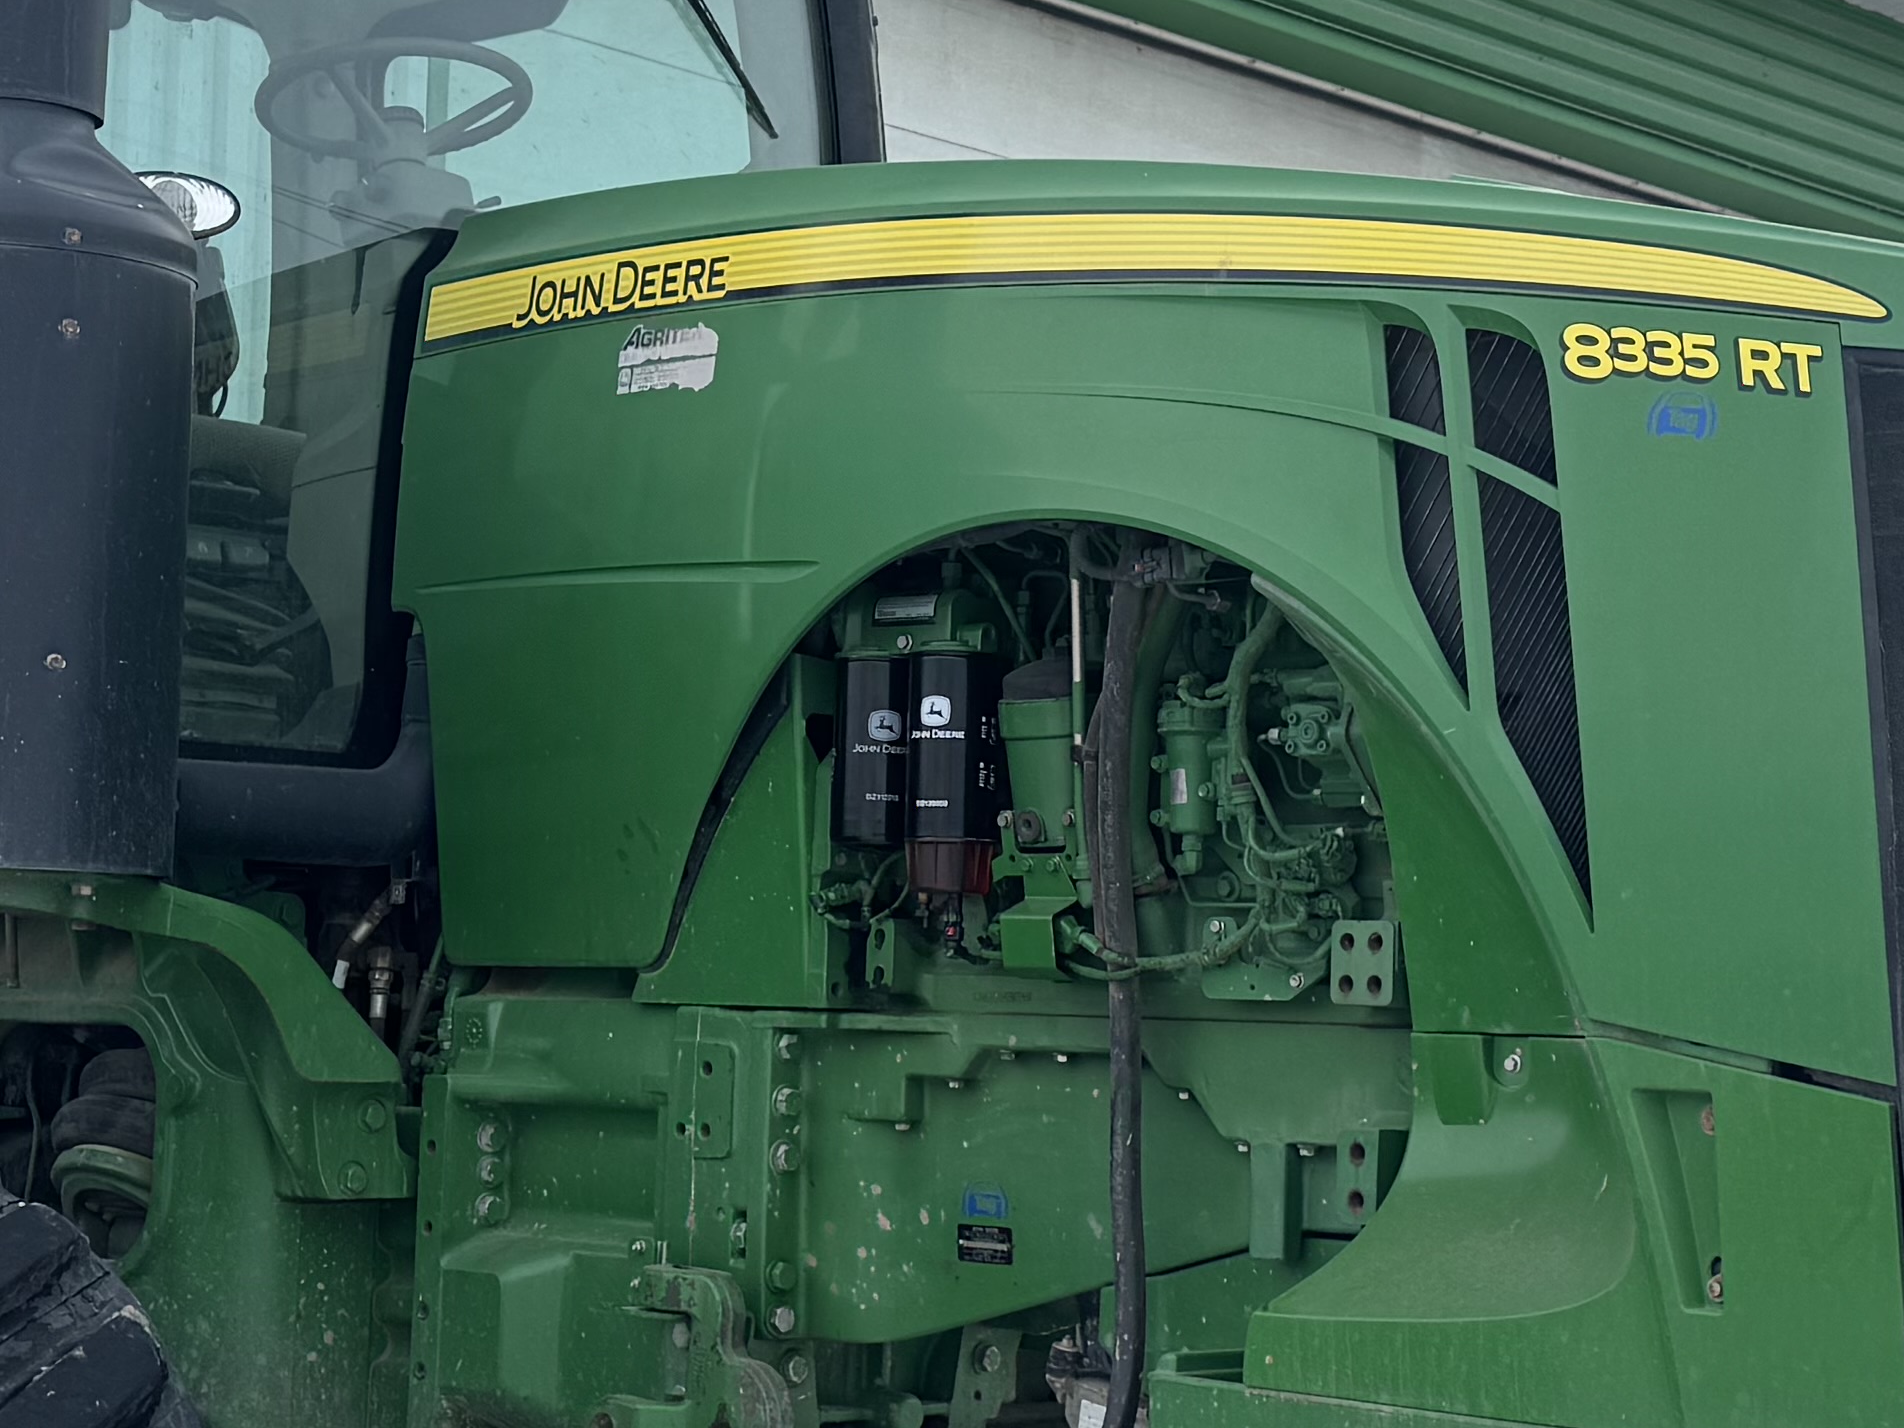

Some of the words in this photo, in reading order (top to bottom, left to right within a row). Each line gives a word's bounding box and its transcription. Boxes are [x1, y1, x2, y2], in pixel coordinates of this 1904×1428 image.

[513, 272, 606, 324] JOHN
[612, 255, 730, 306] DEERE
[1562, 322, 1721, 381] 8335
[1736, 337, 1823, 395] RT
[852, 743, 881, 754] JOHN
